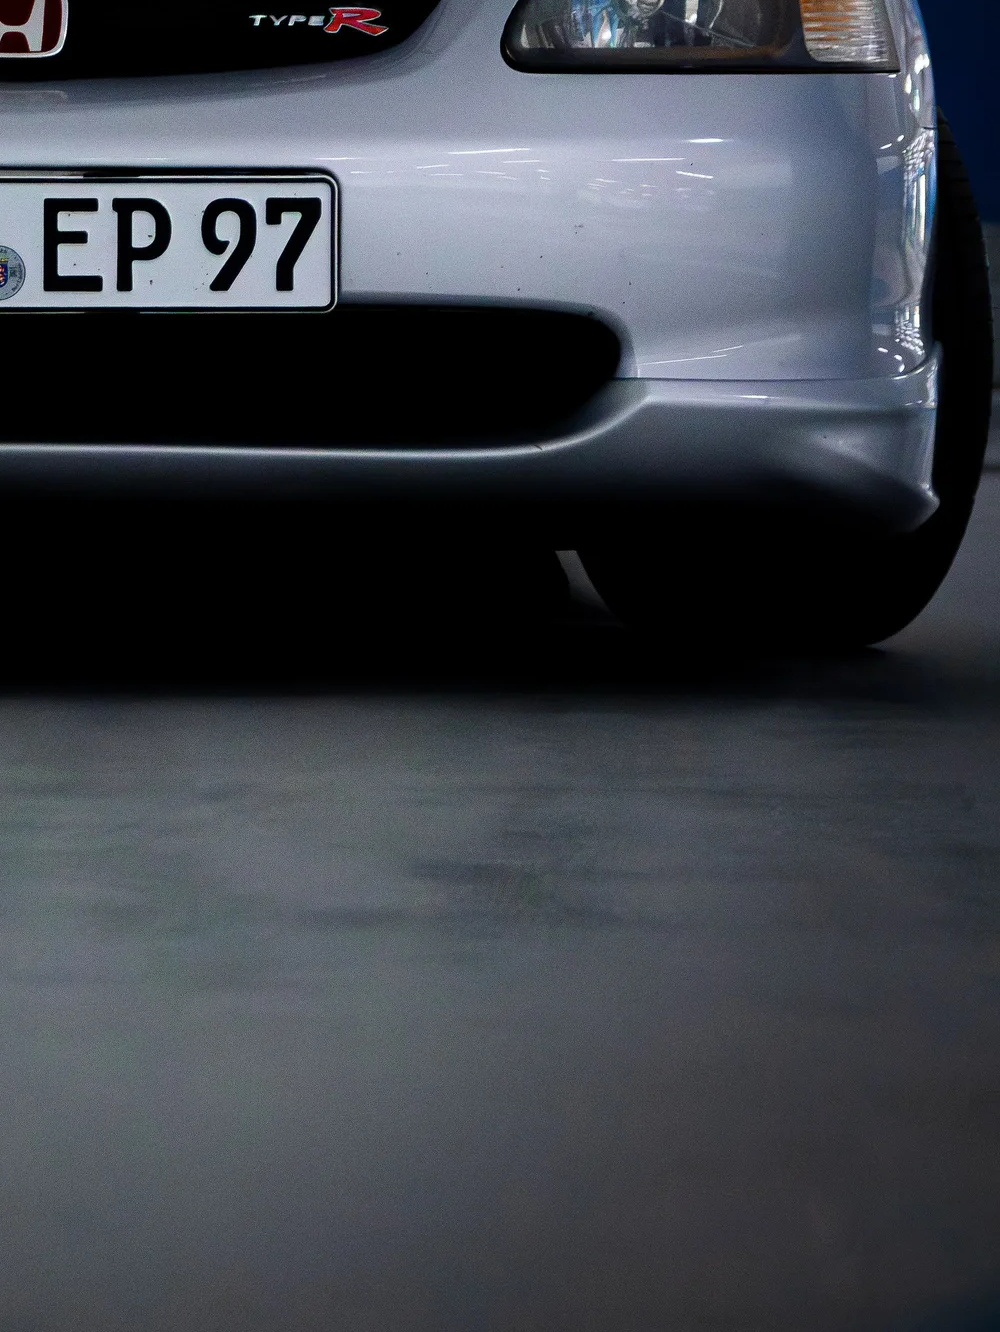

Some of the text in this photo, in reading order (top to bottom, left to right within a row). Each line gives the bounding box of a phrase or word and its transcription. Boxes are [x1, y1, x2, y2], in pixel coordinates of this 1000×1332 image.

[249, 7, 389, 36] TYPE R
[43, 198, 171, 292] EP
[201, 197, 321, 292] 97
